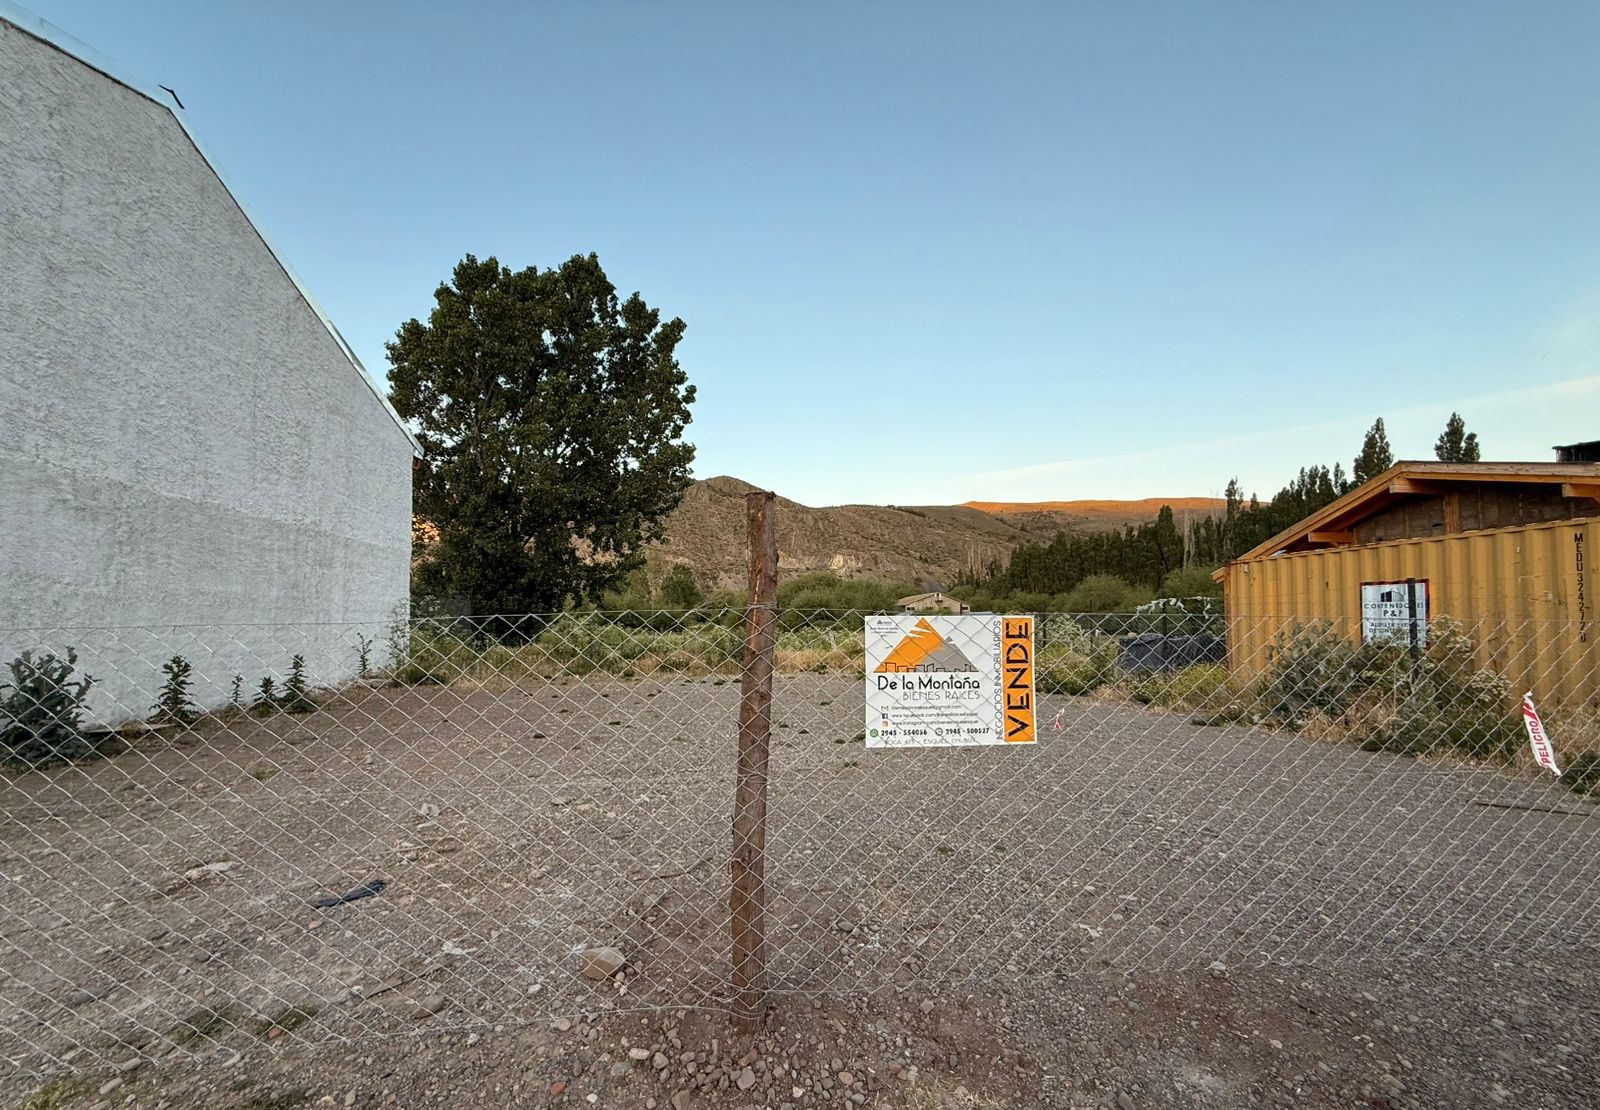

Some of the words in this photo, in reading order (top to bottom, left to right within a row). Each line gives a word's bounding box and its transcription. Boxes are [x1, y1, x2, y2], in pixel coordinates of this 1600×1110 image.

[993, 620, 1002, 687] INMOBILIARIOS
[877, 675, 898, 691] De
[902, 675, 914, 690] la
[918, 674, 980, 690] Montaña
[903, 691, 941, 701] BIENES
[1005, 622, 1030, 737] VENDE
[966, 727, 990, 735] 500527
[994, 688, 1003, 740] NEGOCIOS
[1529, 720, 1551, 764] PELIGRO
